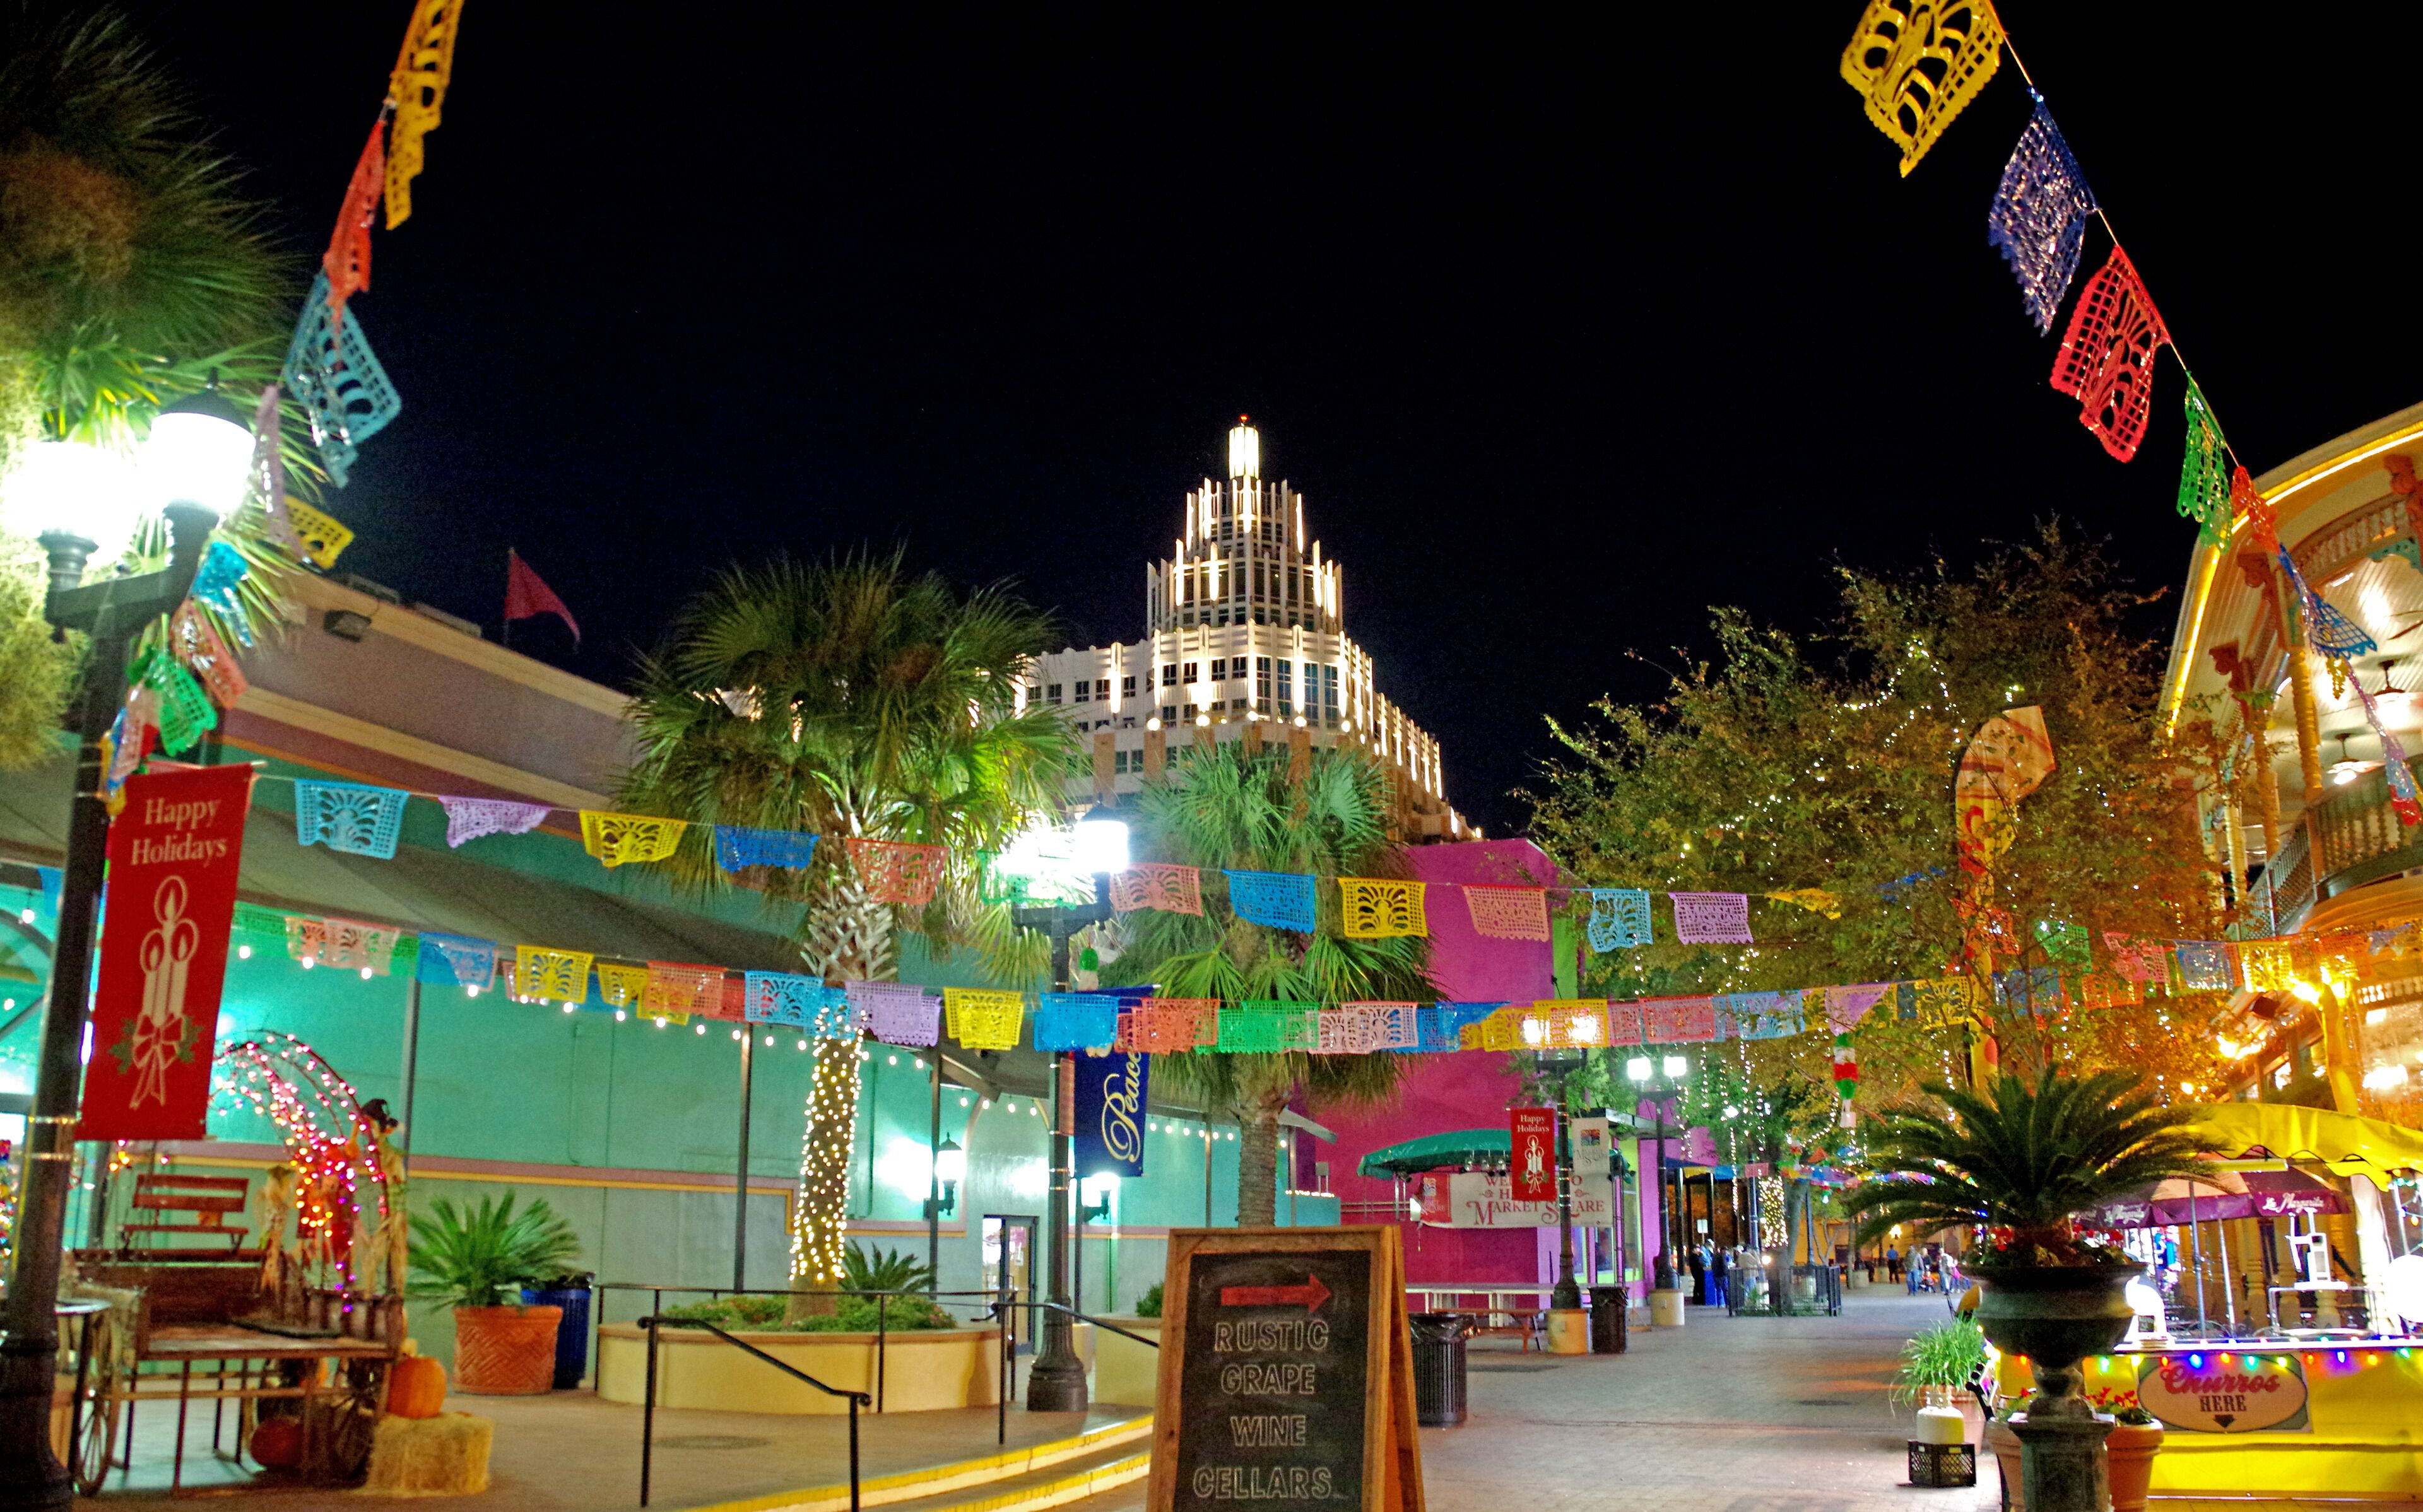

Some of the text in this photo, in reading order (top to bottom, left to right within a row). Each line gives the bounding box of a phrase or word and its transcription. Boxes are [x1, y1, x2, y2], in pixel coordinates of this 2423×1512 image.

[145, 797, 221, 831] Happy
[131, 833, 227, 868] Holidays
[1102, 1046, 1142, 1163] Peace
[1520, 1114, 1545, 1124] Happy
[1517, 1124, 1550, 1134] Holidays
[1466, 1200, 1540, 1226] MARKET
[1214, 1319, 1329, 1352] RUSTIC
[1221, 1363, 1315, 1395] GRAPE
[2160, 1364, 2280, 1394] Churros
[2200, 1395, 2247, 1412] HERE
[1230, 1415, 1306, 1447] WINE
[1193, 1465, 1331, 1499] CELLARS
